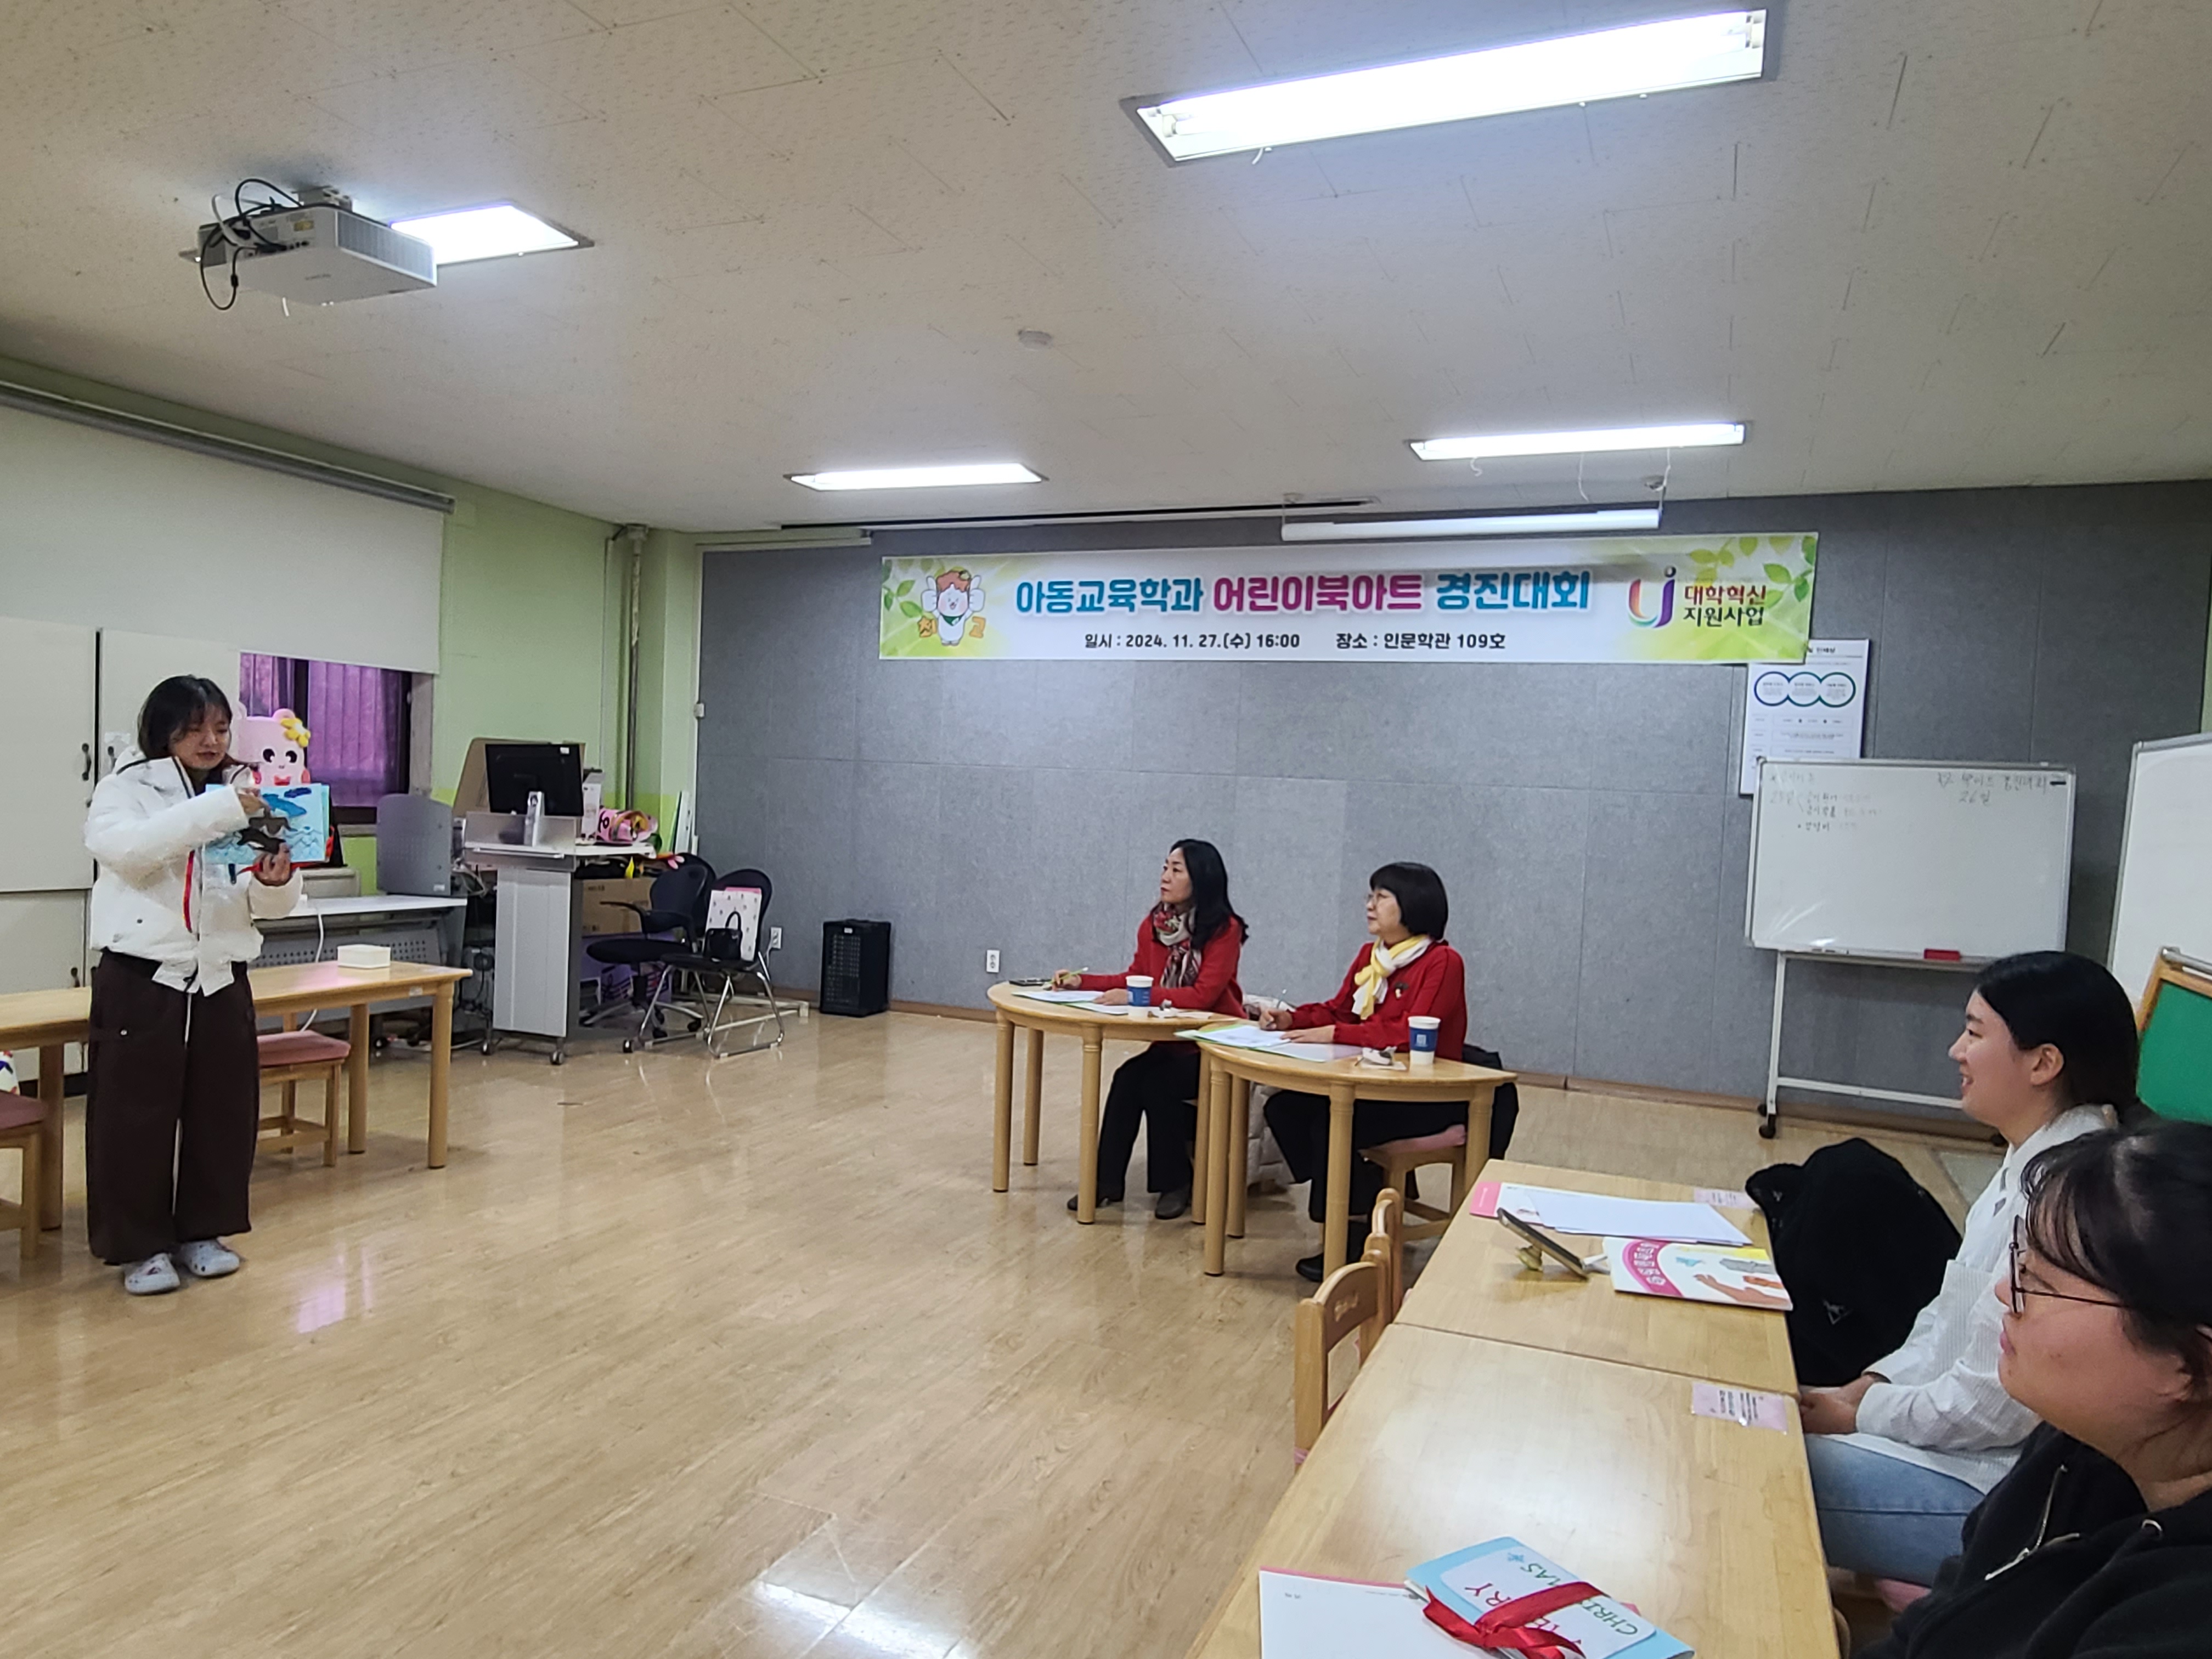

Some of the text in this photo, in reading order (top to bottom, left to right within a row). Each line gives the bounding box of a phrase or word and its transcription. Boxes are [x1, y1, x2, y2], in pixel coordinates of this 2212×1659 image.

[1016, 571, 1590, 613] 아동교육학과 어린이북아트 경진대회
[1684, 585, 1767, 605] 대학혁신
[1683, 606, 1764, 627] 지원사업
[1085, 634, 1113, 648] 일시
[1126, 634, 1167, 648] 2024.
[1172, 634, 1194, 648] 11.
[1256, 634, 1300, 648] 16:00
[1336, 633, 1368, 649] 장소
[1384, 633, 1451, 650] 인문학관
[1457, 633, 1506, 649] 109호
